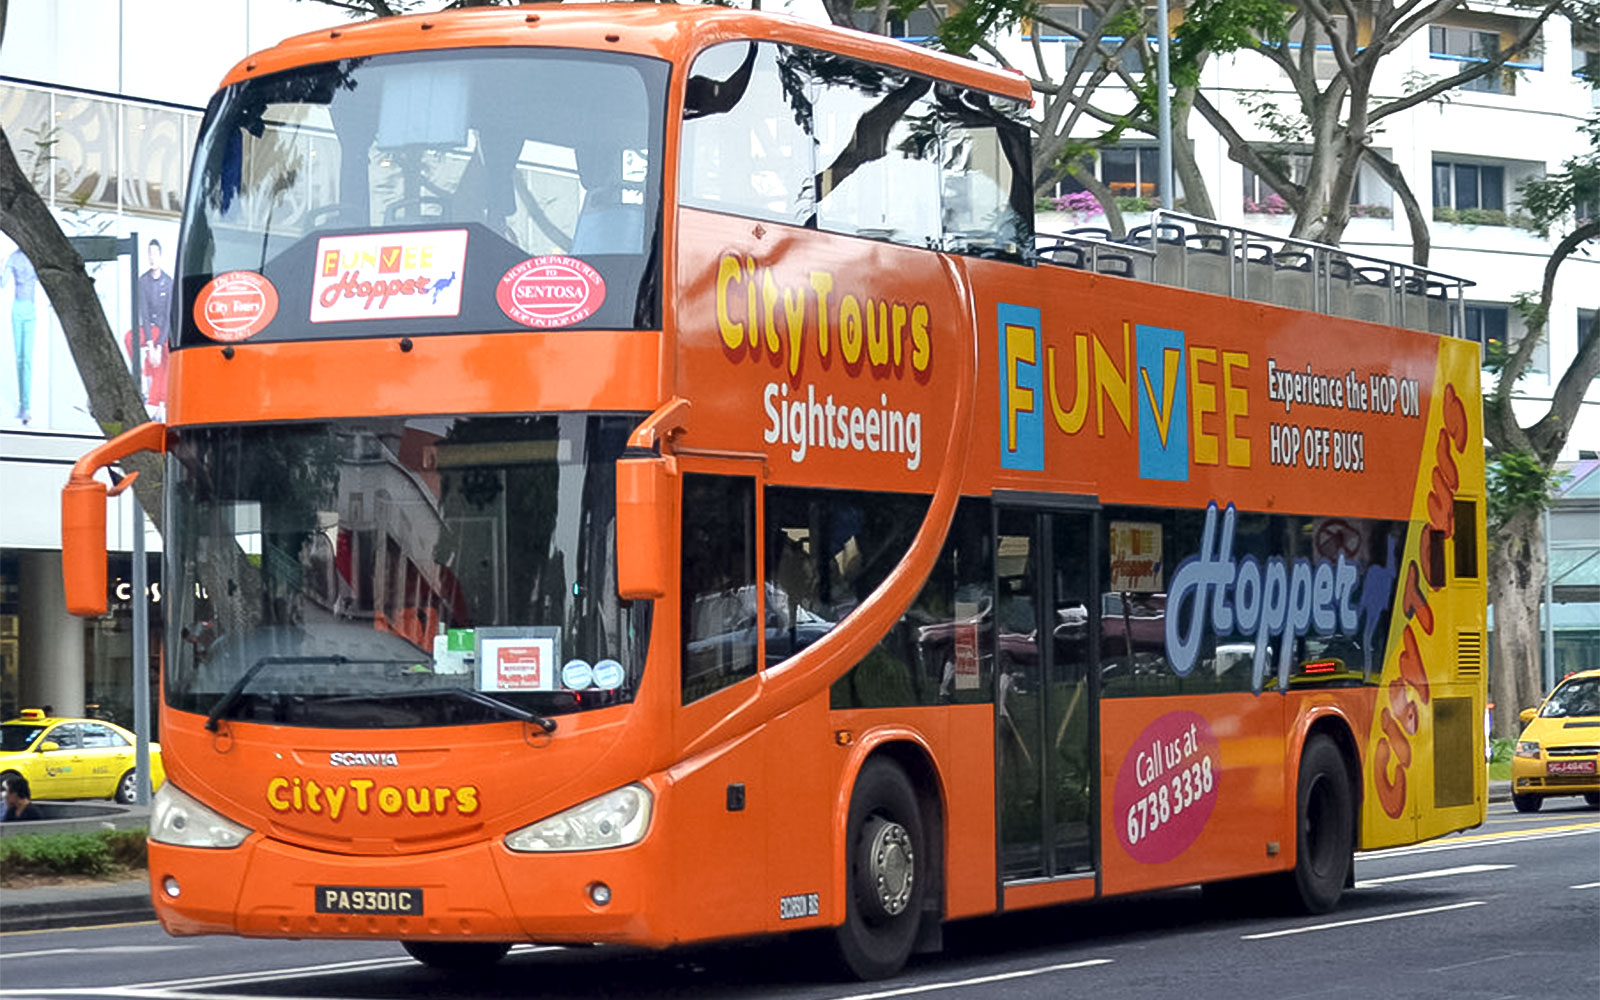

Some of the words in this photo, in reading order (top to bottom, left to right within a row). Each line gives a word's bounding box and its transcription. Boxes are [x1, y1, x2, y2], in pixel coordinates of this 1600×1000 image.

[323, 246, 434, 276] FUNVEE
[503, 262, 532, 283] MOST
[534, 256, 603, 285] DEPARTURES
[208, 301, 228, 316] City
[233, 299, 260, 313] Tours
[319, 270, 431, 310] Hopper
[516, 285, 584, 298] SENTOSA
[1003, 318, 1252, 469] FUNVEE
[1267, 358, 1344, 413] Experience
[1345, 369, 1368, 411] the
[1369, 374, 1398, 414] HOP
[1400, 378, 1420, 418] ON
[763, 382, 922, 471] Sightseeing
[1270, 423, 1300, 467] HOP
[1303, 426, 1331, 469] OFF
[1333, 430, 1365, 472] BUS!
[1165, 500, 1359, 696] Hopper
[1136, 740, 1163, 788] Call
[1165, 738, 1182, 770] us
[1184, 723, 1198, 757] at
[1127, 785, 1170, 845] 6738
[1172, 756, 1214, 815] 3338
[325, 890, 412, 911] PA9301C
